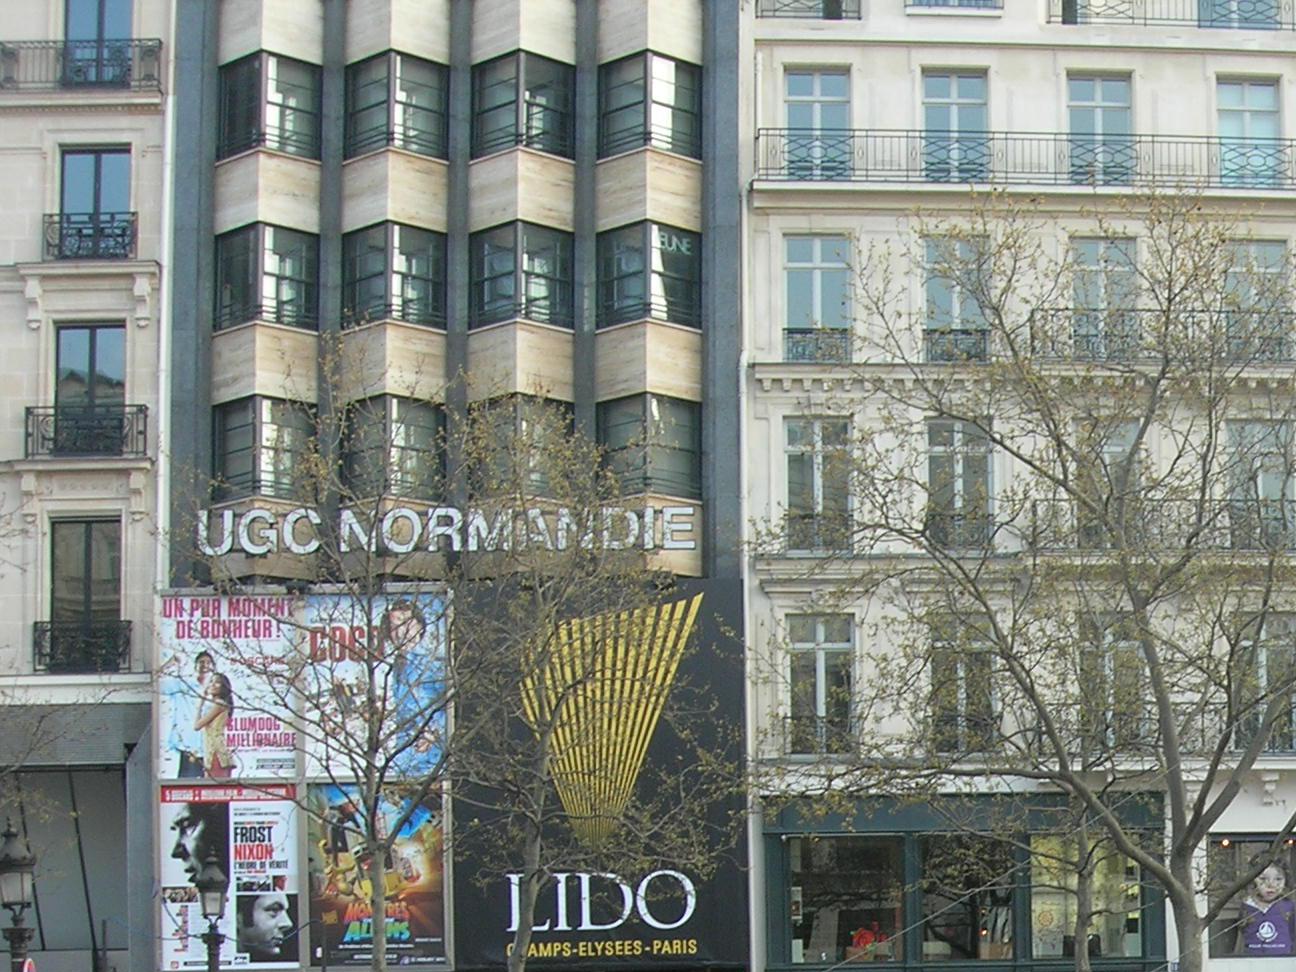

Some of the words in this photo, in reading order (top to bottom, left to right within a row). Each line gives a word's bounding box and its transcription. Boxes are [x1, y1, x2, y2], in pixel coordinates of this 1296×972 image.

[197, 507, 322, 556] UGC
[339, 506, 696, 554] NORMANDIE
[163, 598, 184, 618] UN
[189, 598, 222, 618] PUR
[176, 620, 195, 639] DE
[226, 717, 280, 732] SLUMDOG
[233, 826, 273, 843] FROST
[234, 843, 274, 860] NIXON
[506, 869, 696, 932] LIDO
